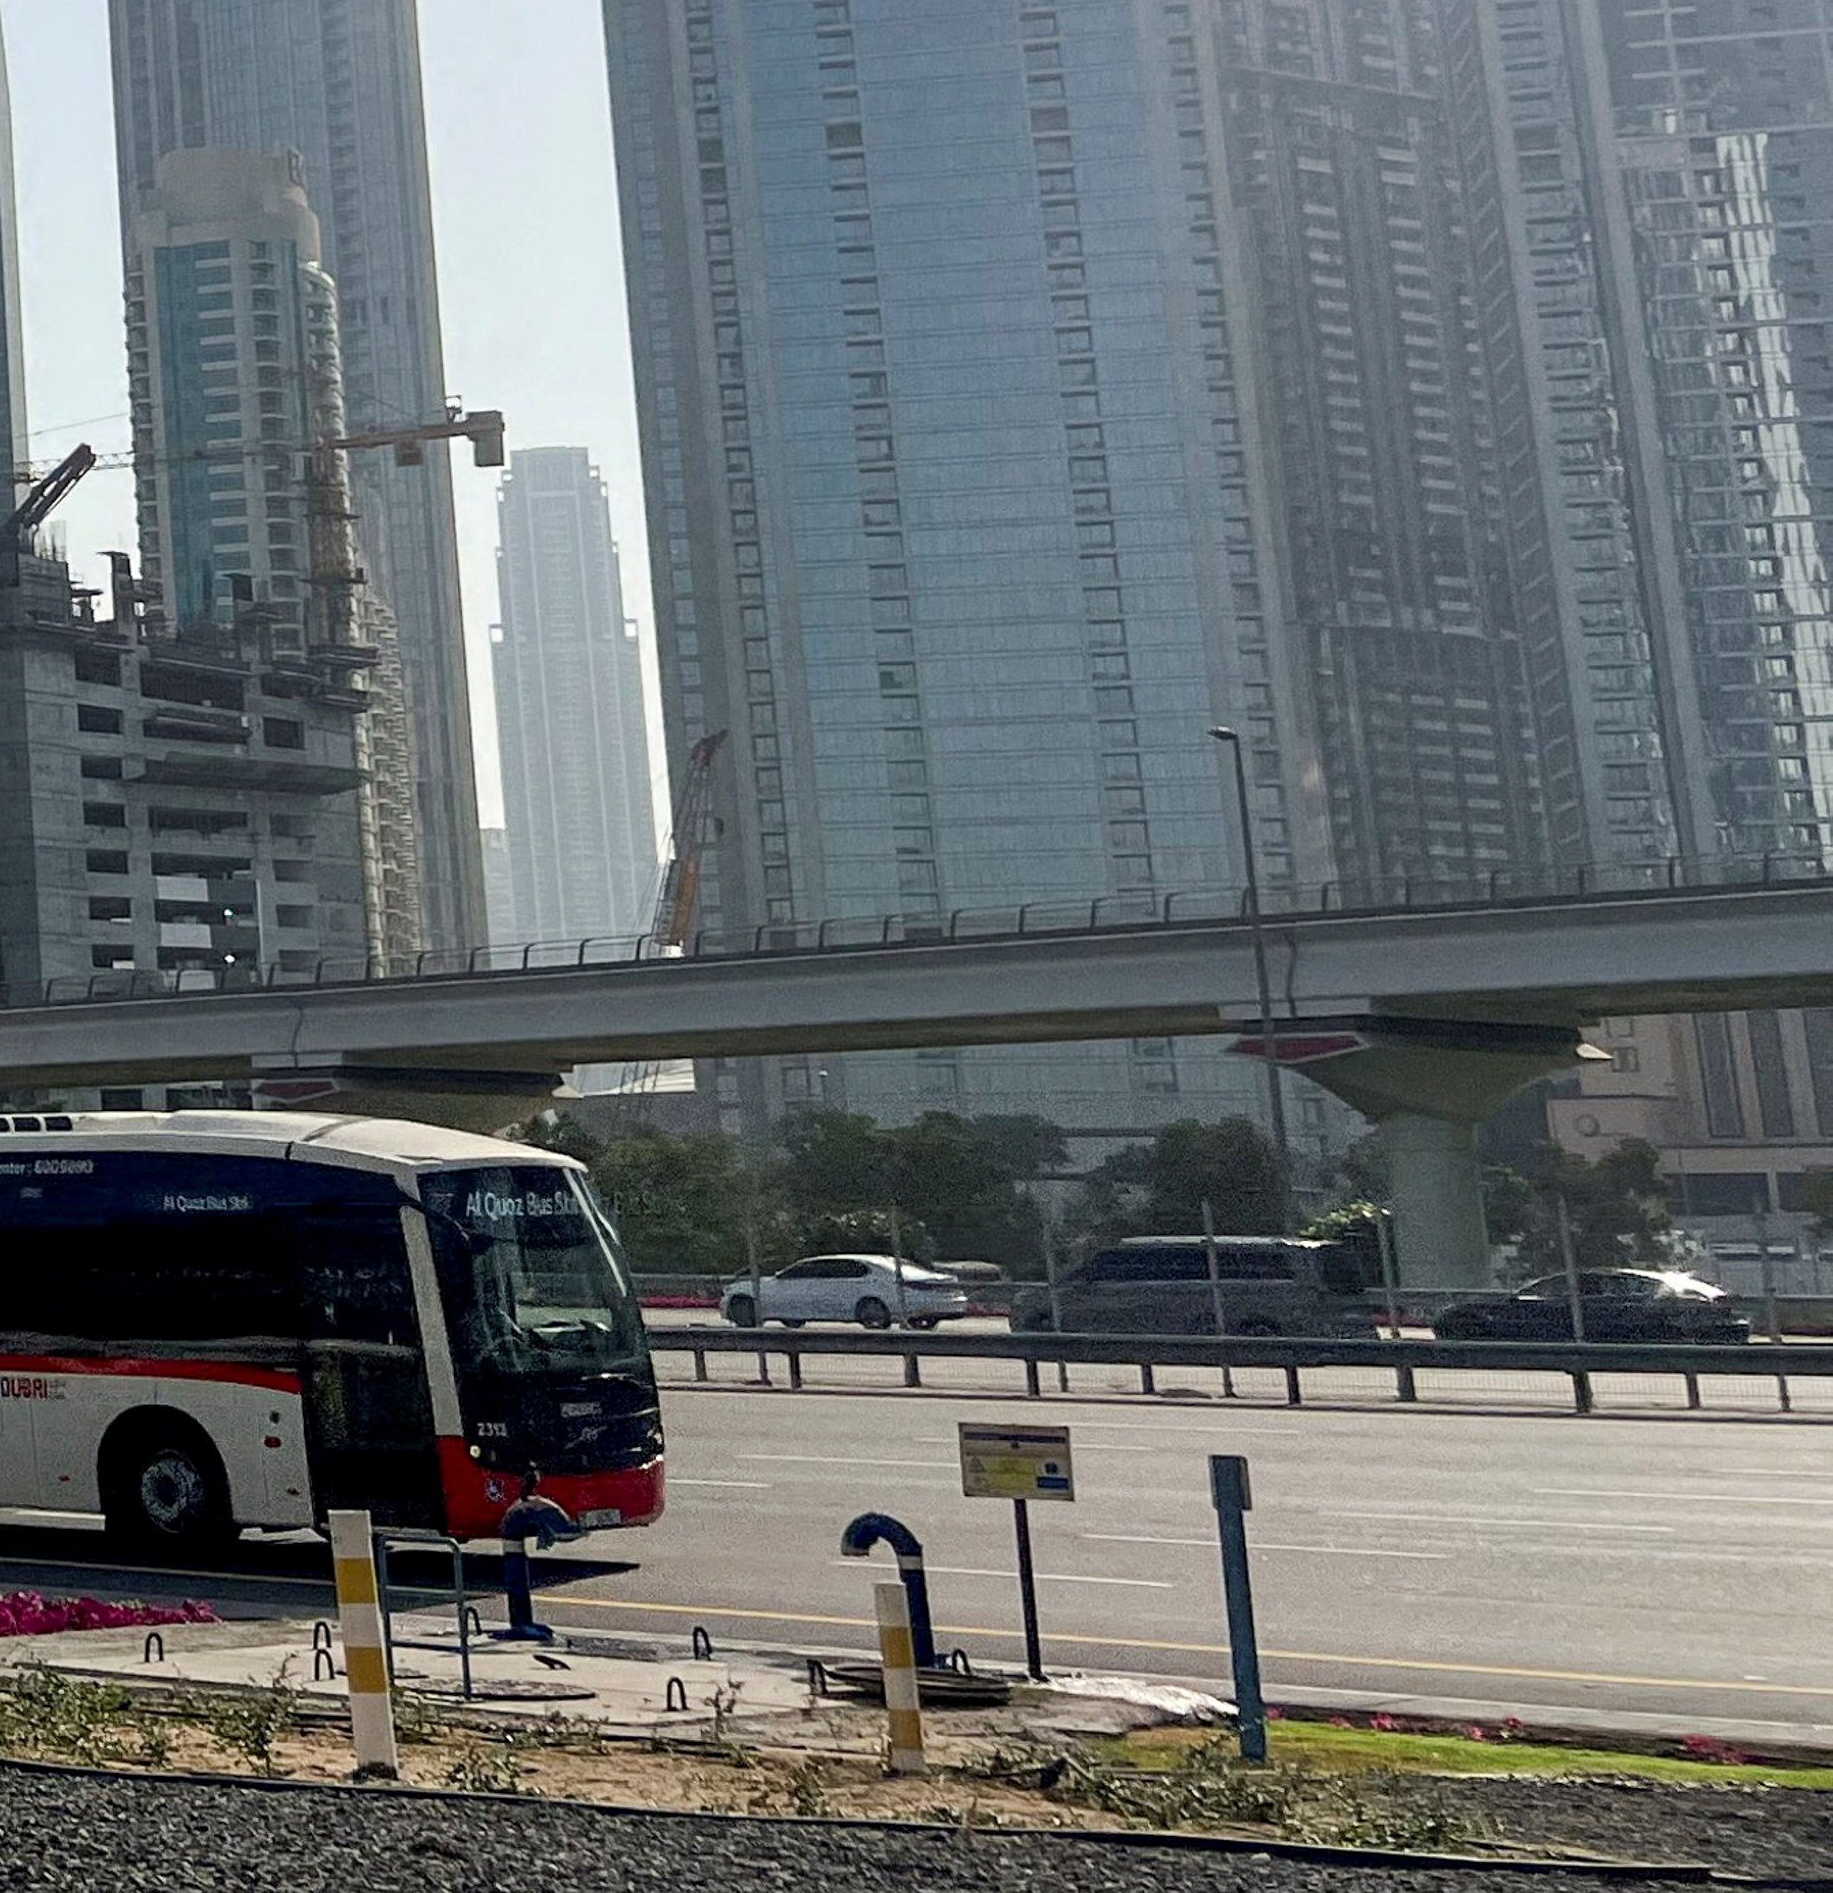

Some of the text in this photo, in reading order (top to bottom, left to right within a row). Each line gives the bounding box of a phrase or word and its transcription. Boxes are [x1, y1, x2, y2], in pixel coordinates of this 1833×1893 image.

[465, 1190, 481, 1217] Al
[484, 1192, 524, 1221] Quoz
[526, 1191, 553, 1217] Bus
